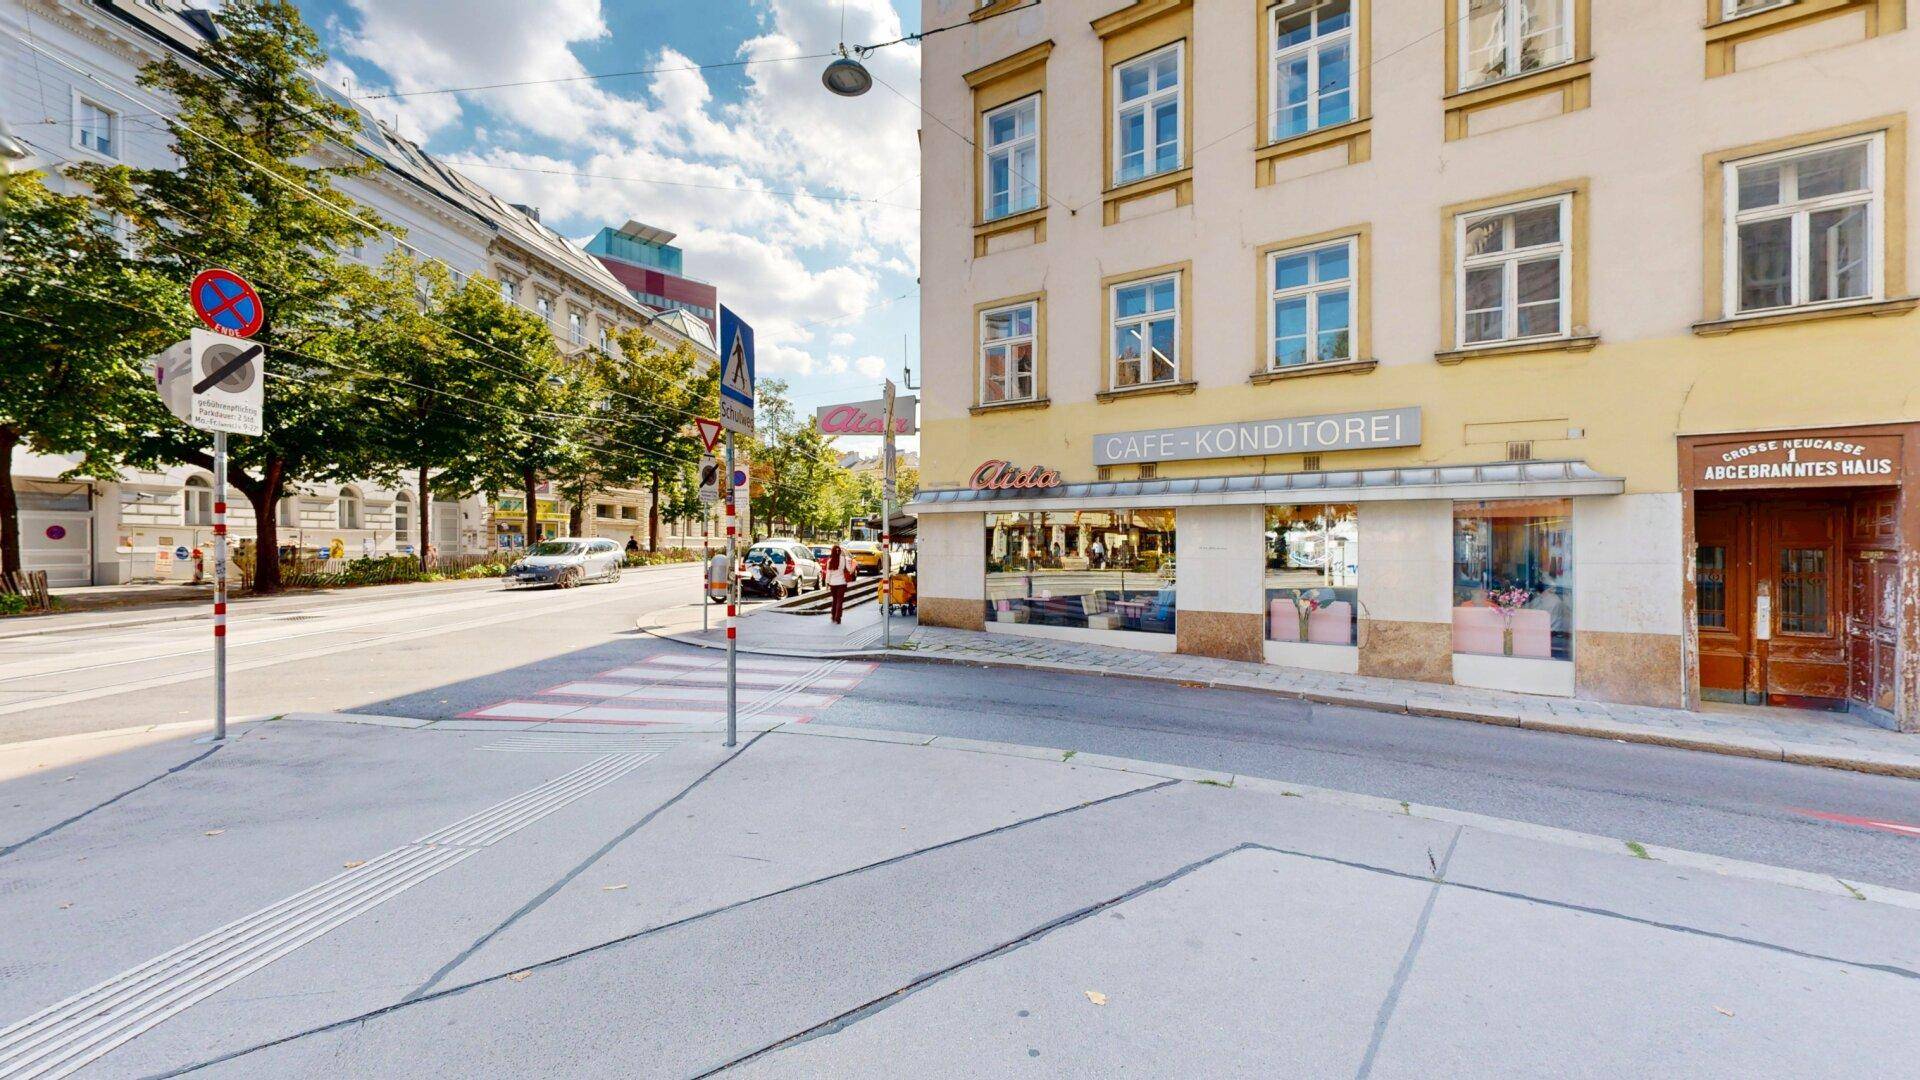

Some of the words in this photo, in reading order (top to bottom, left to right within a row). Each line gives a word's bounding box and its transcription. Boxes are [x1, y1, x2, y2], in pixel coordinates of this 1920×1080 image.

[214, 323, 242, 337] ENDE
[721, 401, 754, 432] Schulweg
[1722, 441, 1778, 462] GROSSE
[1783, 439, 1866, 455] NEUGASSE
[1787, 448, 1798, 462] 1
[968, 460, 1063, 490] Aida
[1704, 461, 1838, 480] ABGEBRANNTES
[1841, 458, 1892, 475] HAUS
